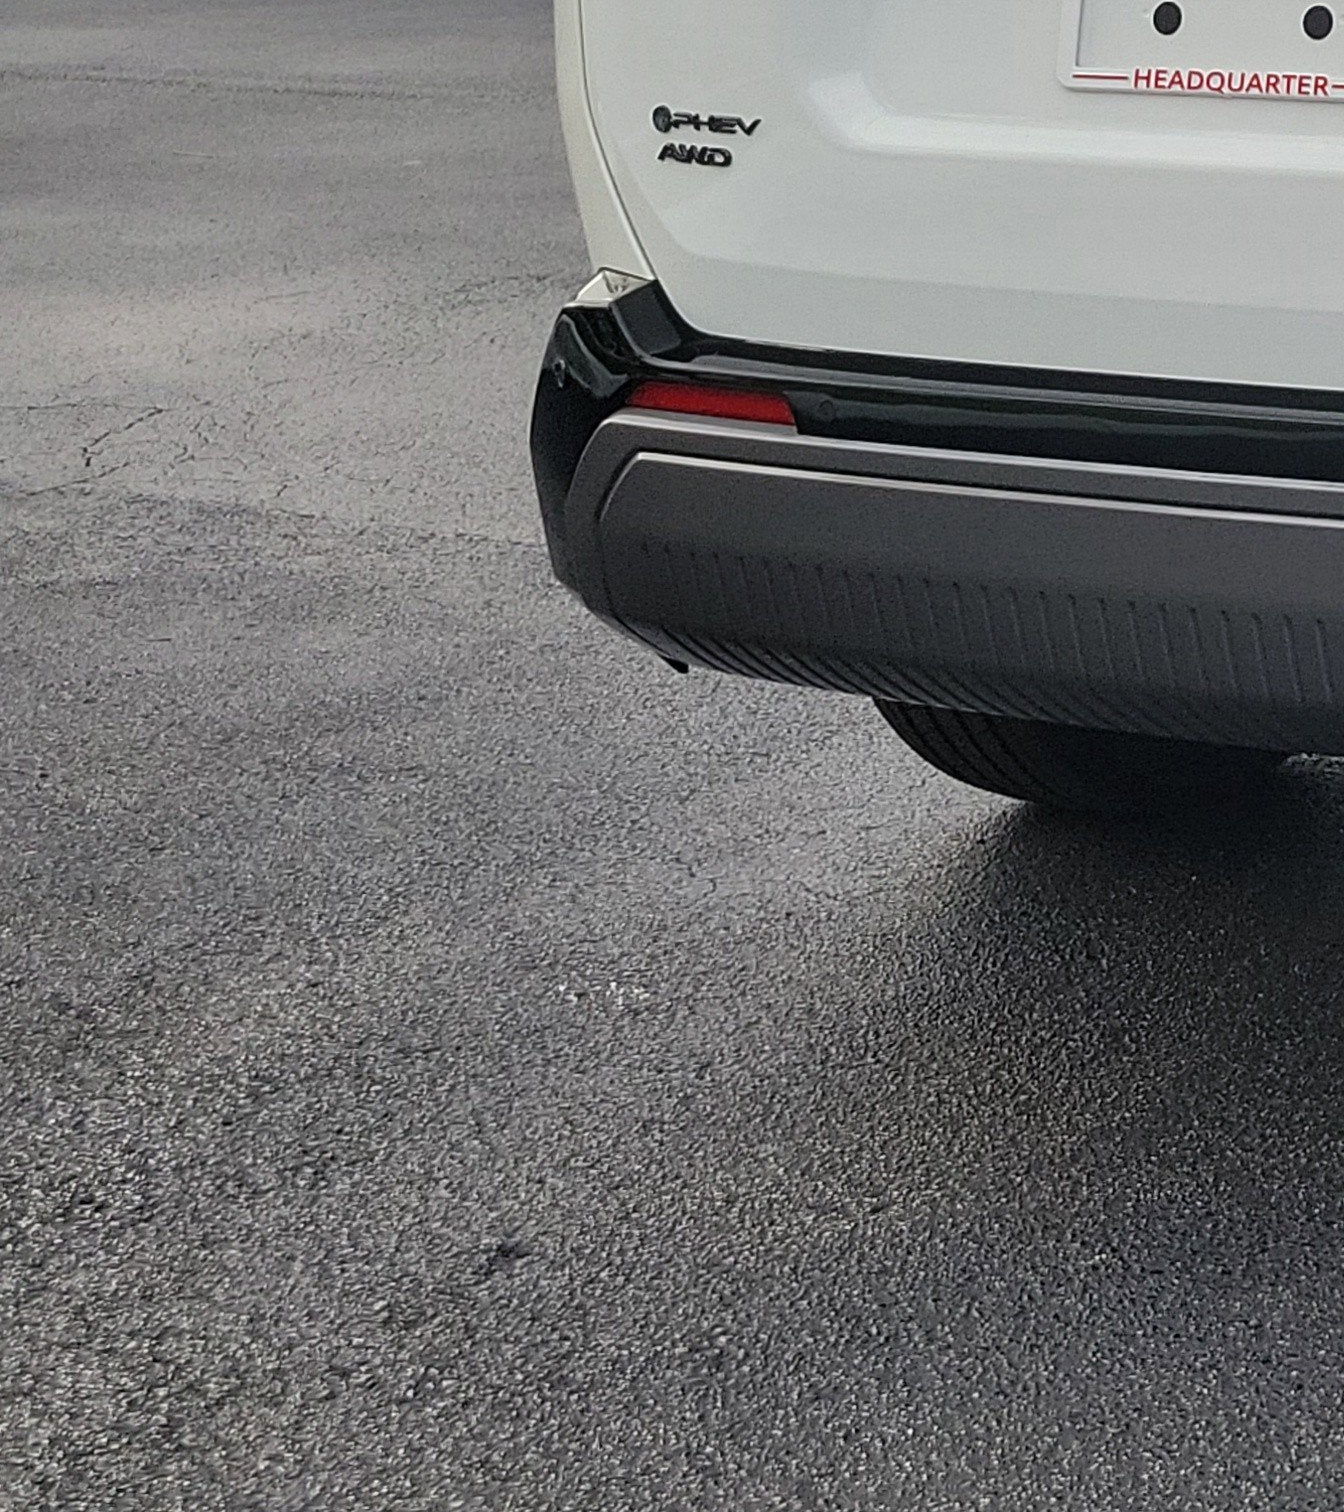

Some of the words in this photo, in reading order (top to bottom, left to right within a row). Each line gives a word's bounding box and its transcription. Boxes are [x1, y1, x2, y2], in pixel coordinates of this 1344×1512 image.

[1133, 67, 1330, 96] HEADQUARTER
[671, 111, 762, 136] PHEV
[657, 142, 733, 167] AWD
